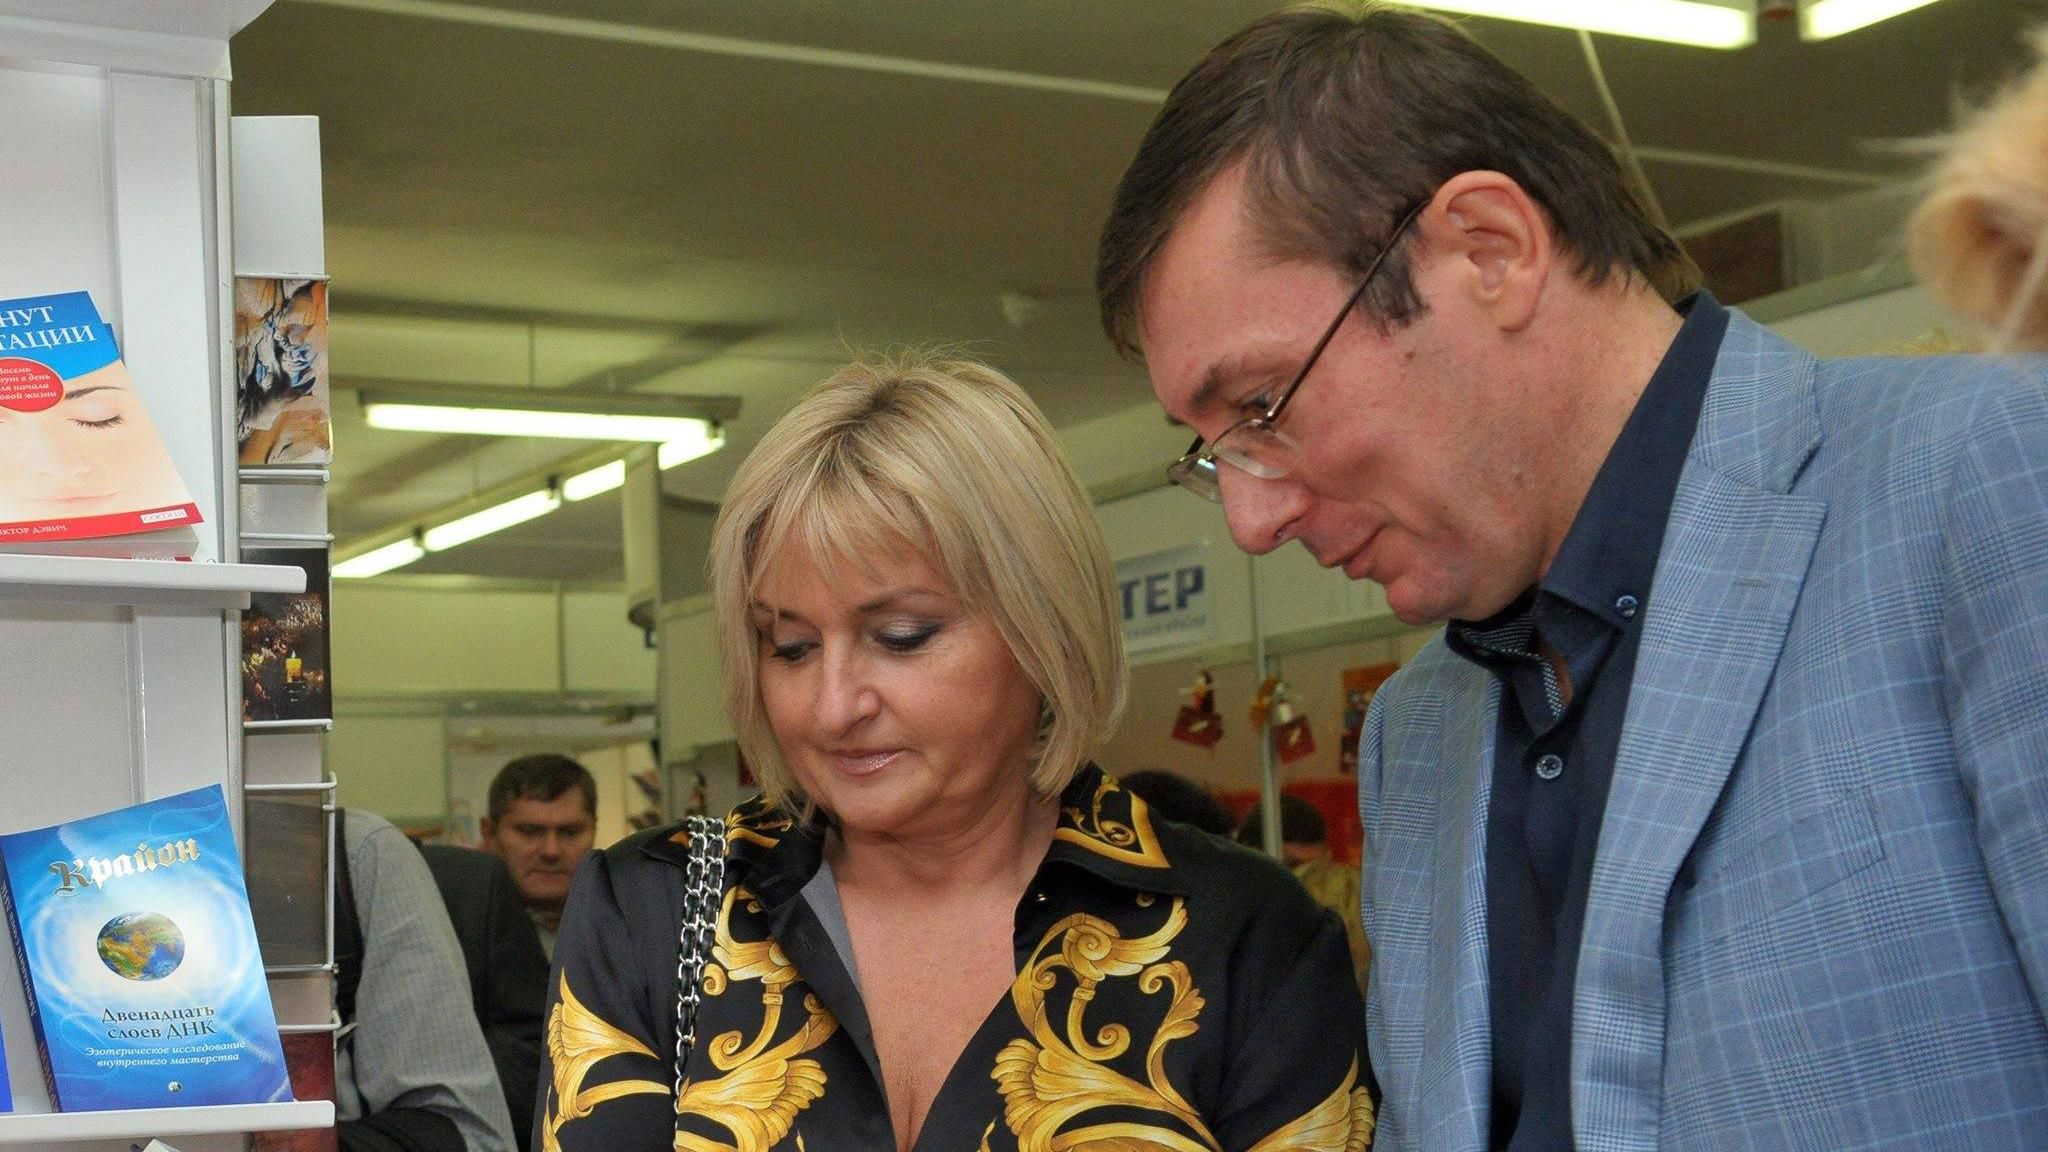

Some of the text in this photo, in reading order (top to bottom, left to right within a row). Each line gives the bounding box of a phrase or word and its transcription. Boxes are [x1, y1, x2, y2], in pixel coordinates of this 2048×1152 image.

[49, 837, 200, 898] Крайон
[102, 1006, 215, 1025] Двенадцать
[107, 1020, 217, 1040] слоев ДНК
[86, 1040, 247, 1058] Эзотерическое исследование
[96, 1054, 240, 1069] внутреннего мастерства
